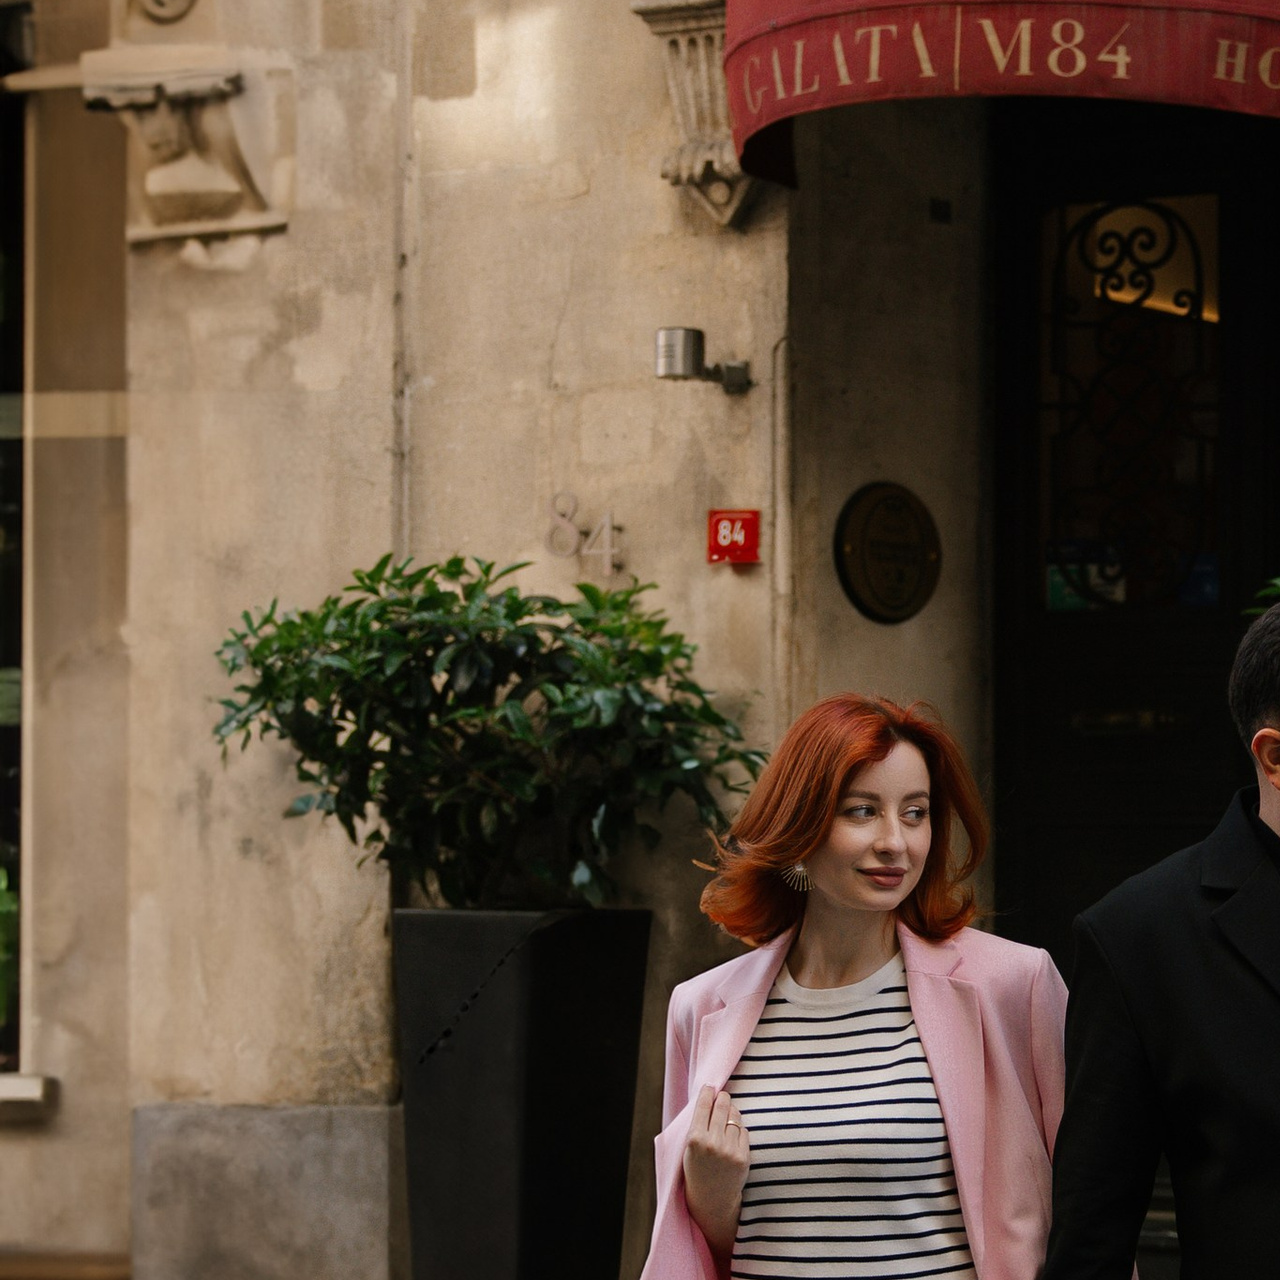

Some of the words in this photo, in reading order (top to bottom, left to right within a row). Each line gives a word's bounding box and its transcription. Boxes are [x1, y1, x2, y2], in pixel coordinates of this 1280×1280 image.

[976, 17, 1132, 80] M84
[544, 491, 621, 576] 84
[716, 518, 746, 547] 84
